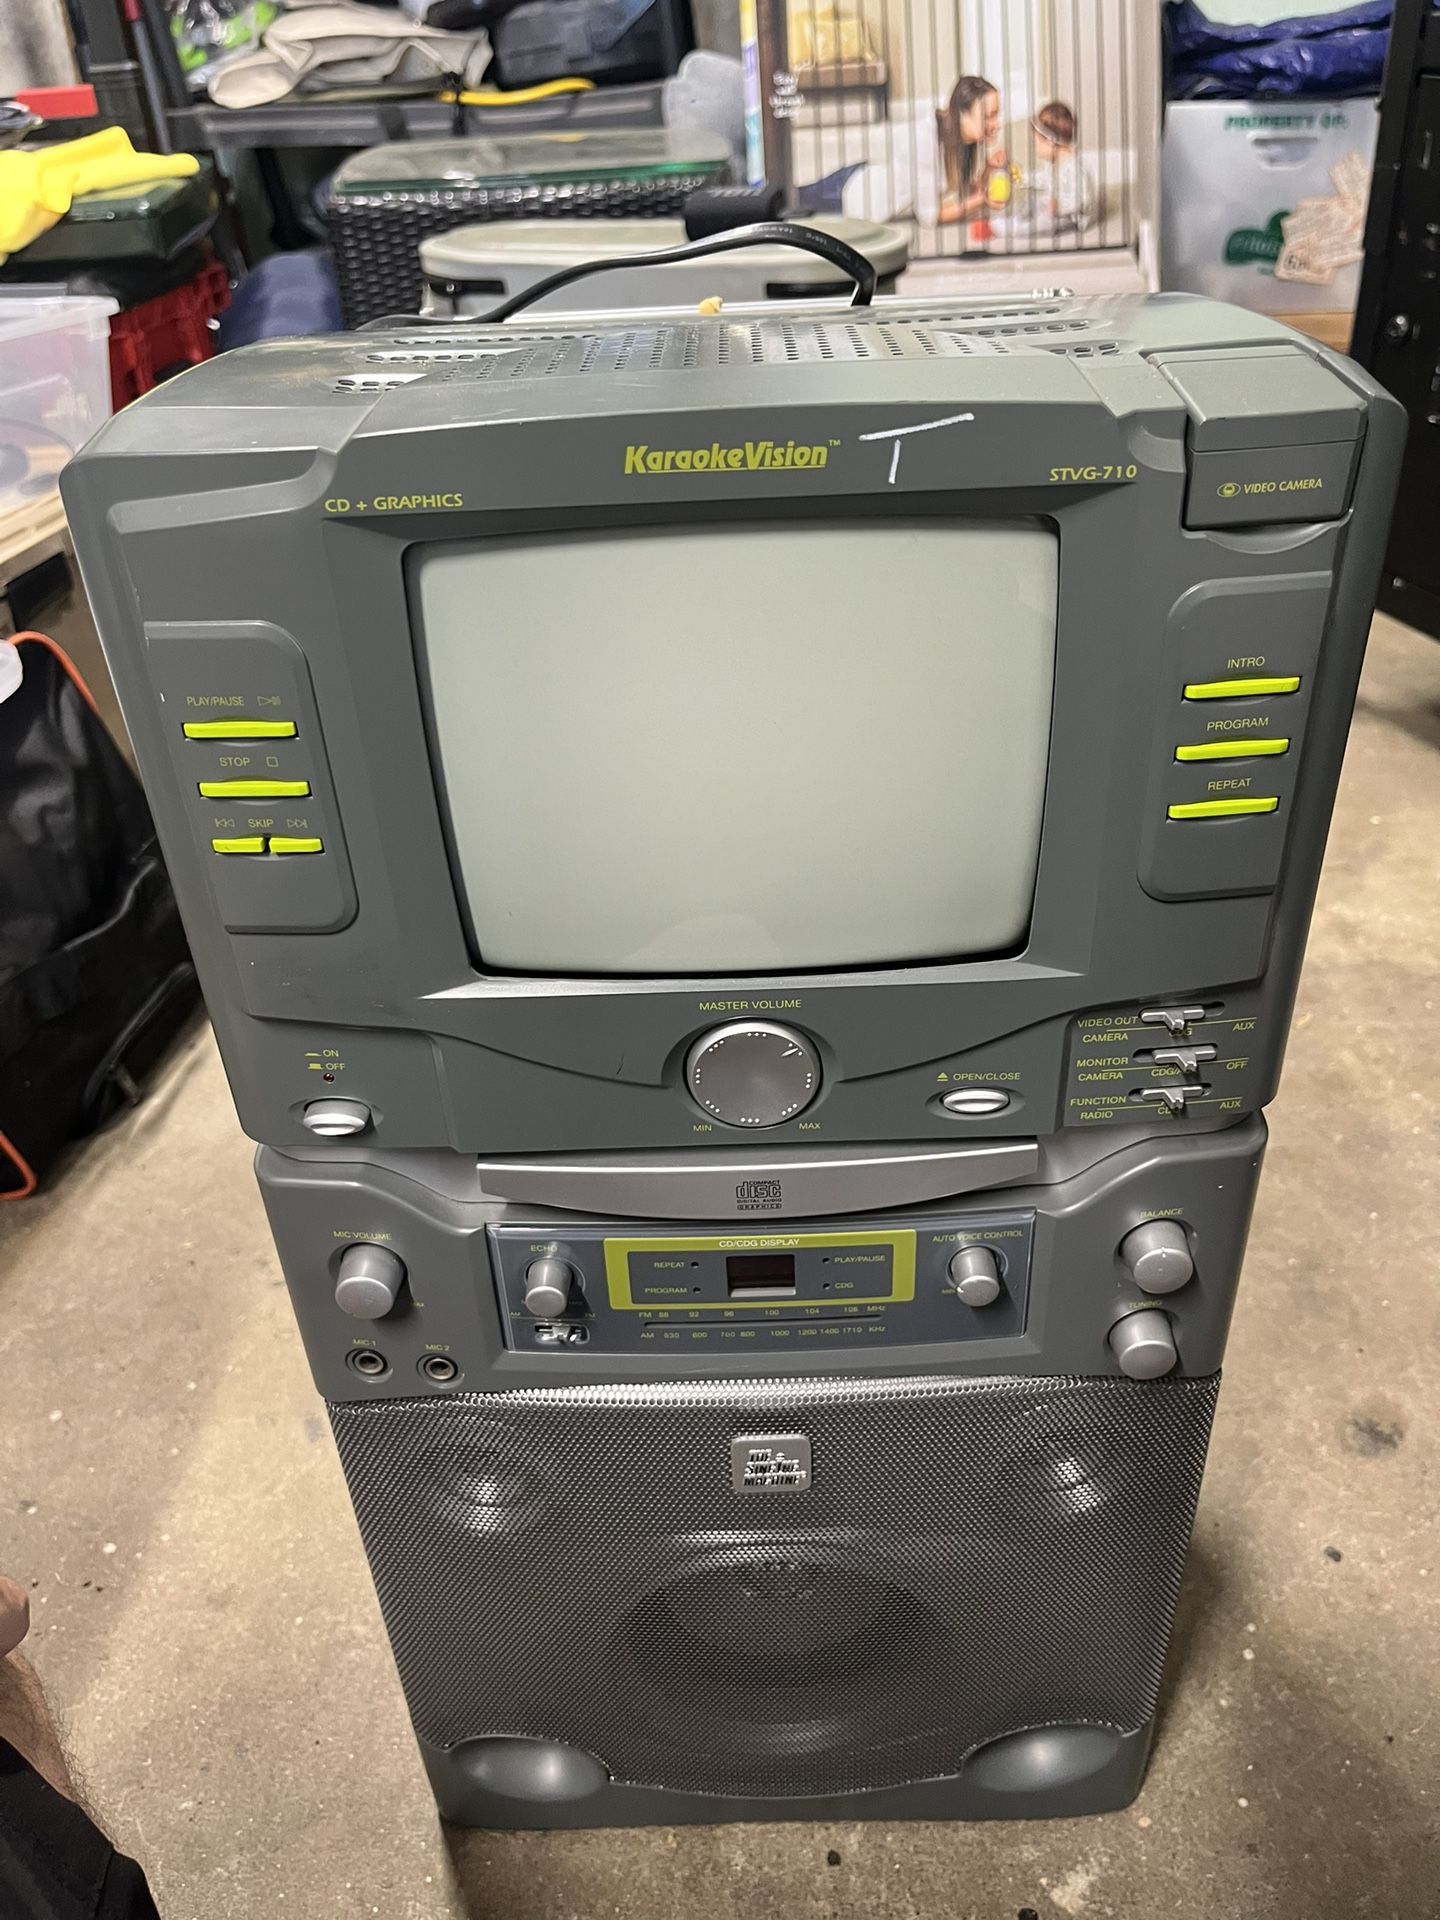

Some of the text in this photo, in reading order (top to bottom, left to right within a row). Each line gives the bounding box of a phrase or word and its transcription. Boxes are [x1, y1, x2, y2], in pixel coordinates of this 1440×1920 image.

[624, 441, 828, 474] KaraokeVision
[1049, 464, 1138, 481] STVG-710
[1243, 478, 1323, 494] VIDEO CAMERA
[325, 493, 463, 512] CD + GRAPHICS
[1227, 656, 1266, 669] INTRO
[186, 696, 245, 707] PLAY/PAUSE
[1206, 717, 1270, 731] PROGRAM
[219, 757, 251, 767] STOP
[1207, 777, 1252, 791] REPEAT
[247, 818, 274, 828] SKIP
[699, 999, 802, 1011] MASTER VOLUME
[1077, 1016, 1138, 1028] VIDEO OUT
[1232, 1021, 1255, 1032] AUX
[1082, 1032, 1129, 1043] CAMERA
[322, 1049, 339, 1058] ON
[325, 1062, 345, 1071] OFF
[1076, 1056, 1129, 1068] MONITOR
[1226, 1060, 1249, 1071] OFF
[952, 1072, 1021, 1081] OPEN/CLOSE
[1078, 1071, 1124, 1082] CAMERA
[1070, 1095, 1127, 1107] FUNCTION
[1219, 1100, 1242, 1110] AUX
[1080, 1110, 1114, 1120] RADIO
[693, 1123, 712, 1132] MIN
[799, 1122, 821, 1131] MAX
[736, 1181, 781, 1199] disc
[1140, 1208, 1184, 1219] BALANCE
[333, 1230, 392, 1240] MIC VOLUME
[984, 1230, 1023, 1238] CONTROL
[530, 1244, 557, 1252] ECHO
[719, 1238, 800, 1248] CD/CDG DISPLAY
[834, 1255, 886, 1263] PLAY/PAUSE
